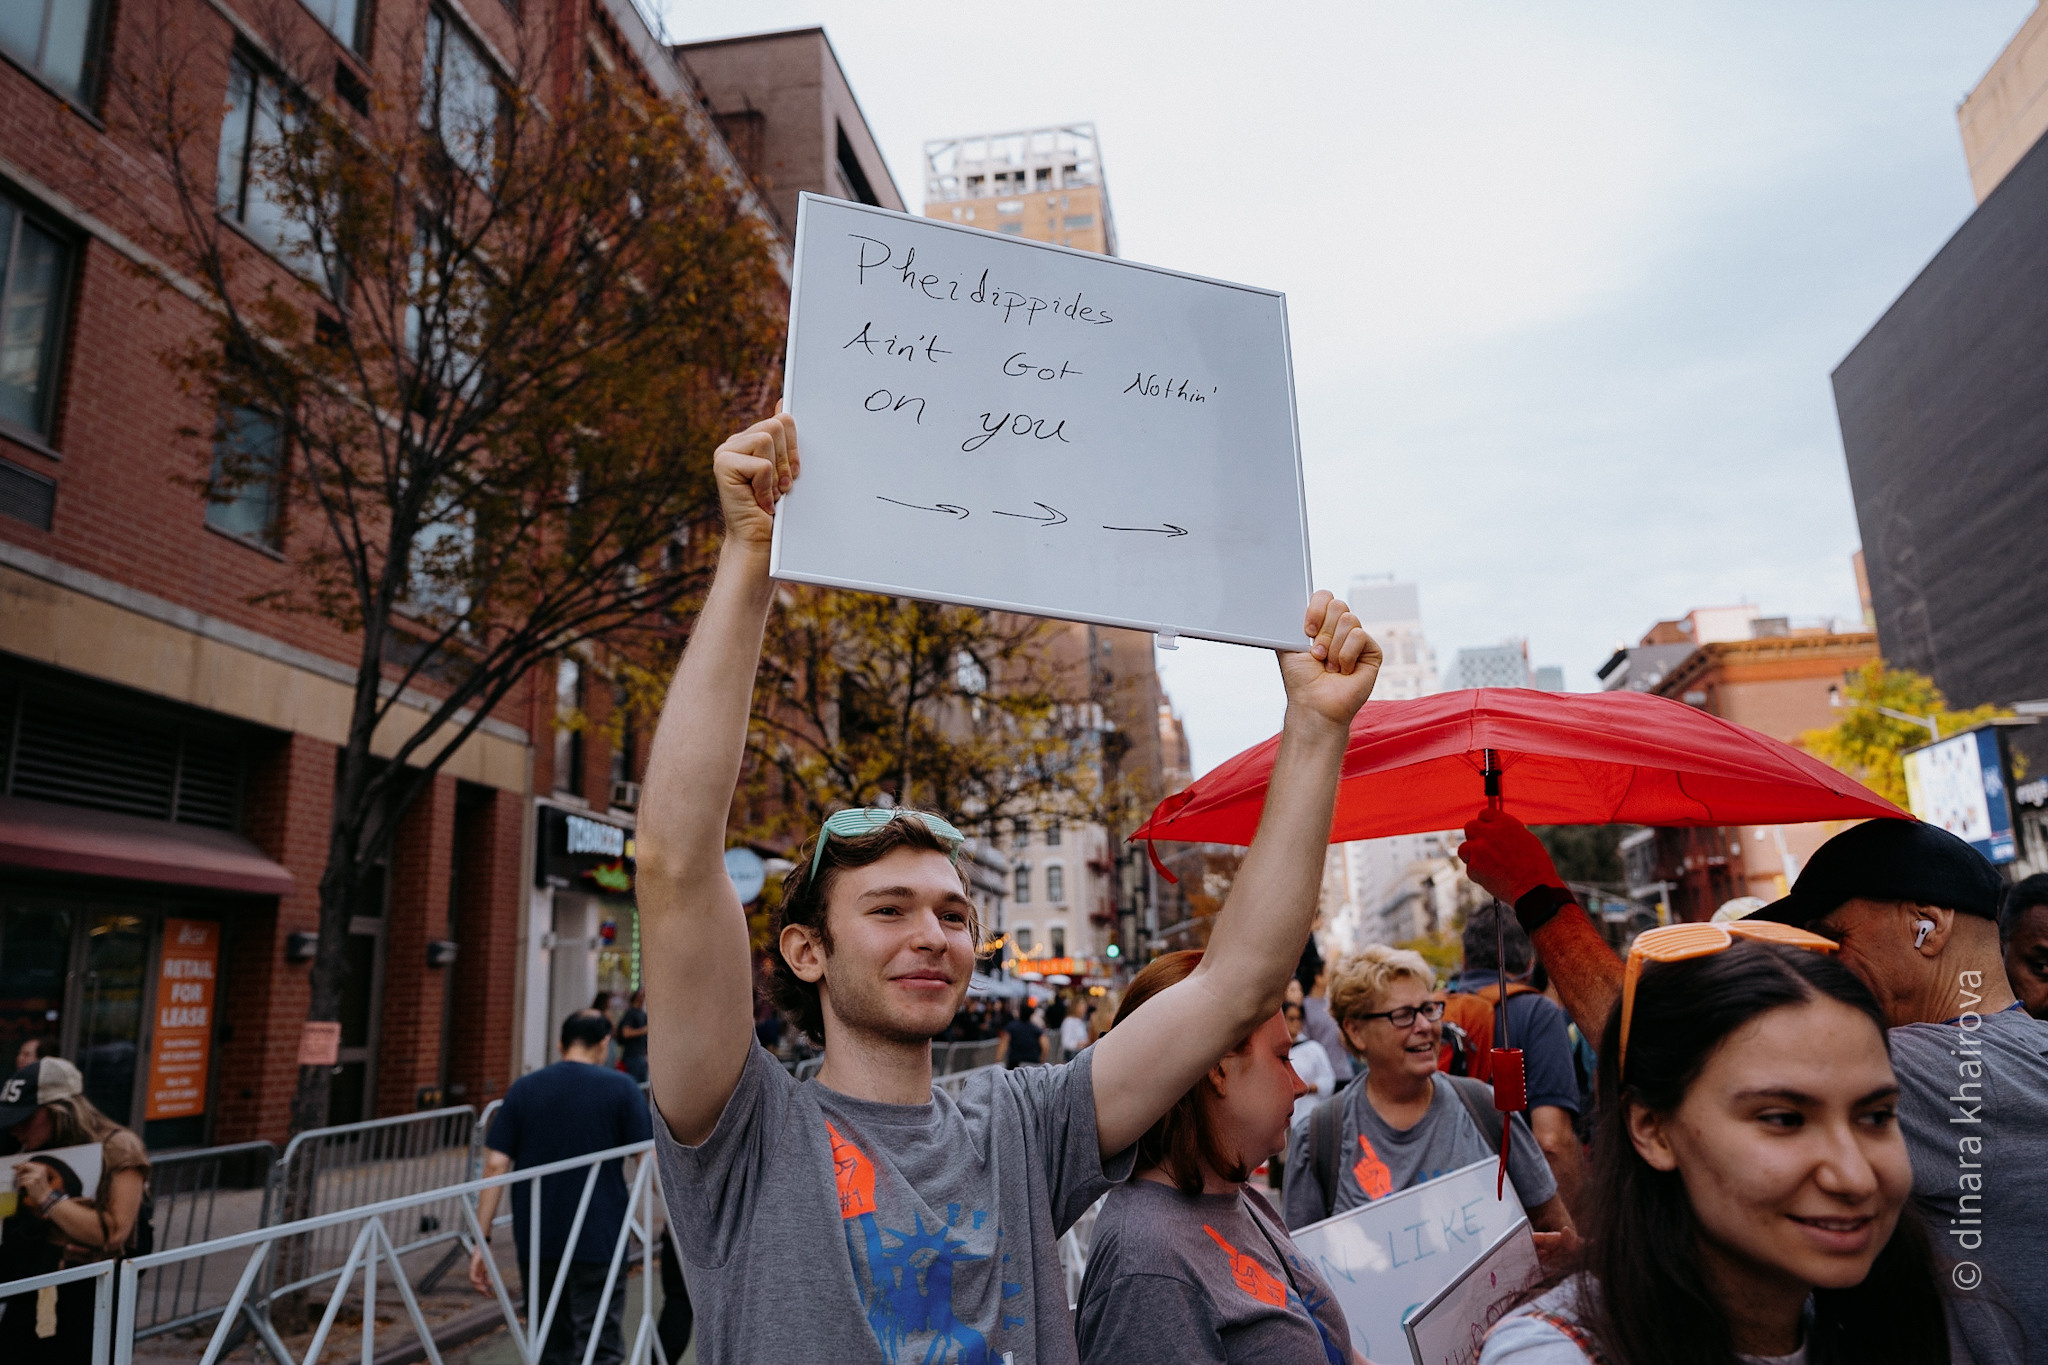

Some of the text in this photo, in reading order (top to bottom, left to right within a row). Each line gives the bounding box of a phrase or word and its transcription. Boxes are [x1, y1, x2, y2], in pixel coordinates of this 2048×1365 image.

[849, 234, 1114, 326] Pheidippides
[843, 322, 1217, 403] Ain't Got Nothin'
[865, 389, 1070, 452] on you
[163, 957, 215, 980] RETAIL
[171, 981, 204, 1004] FOR
[161, 1005, 209, 1028] LEASE
[840, 1188, 863, 1213] #1
[1388, 1197, 1486, 1269] LIKE
